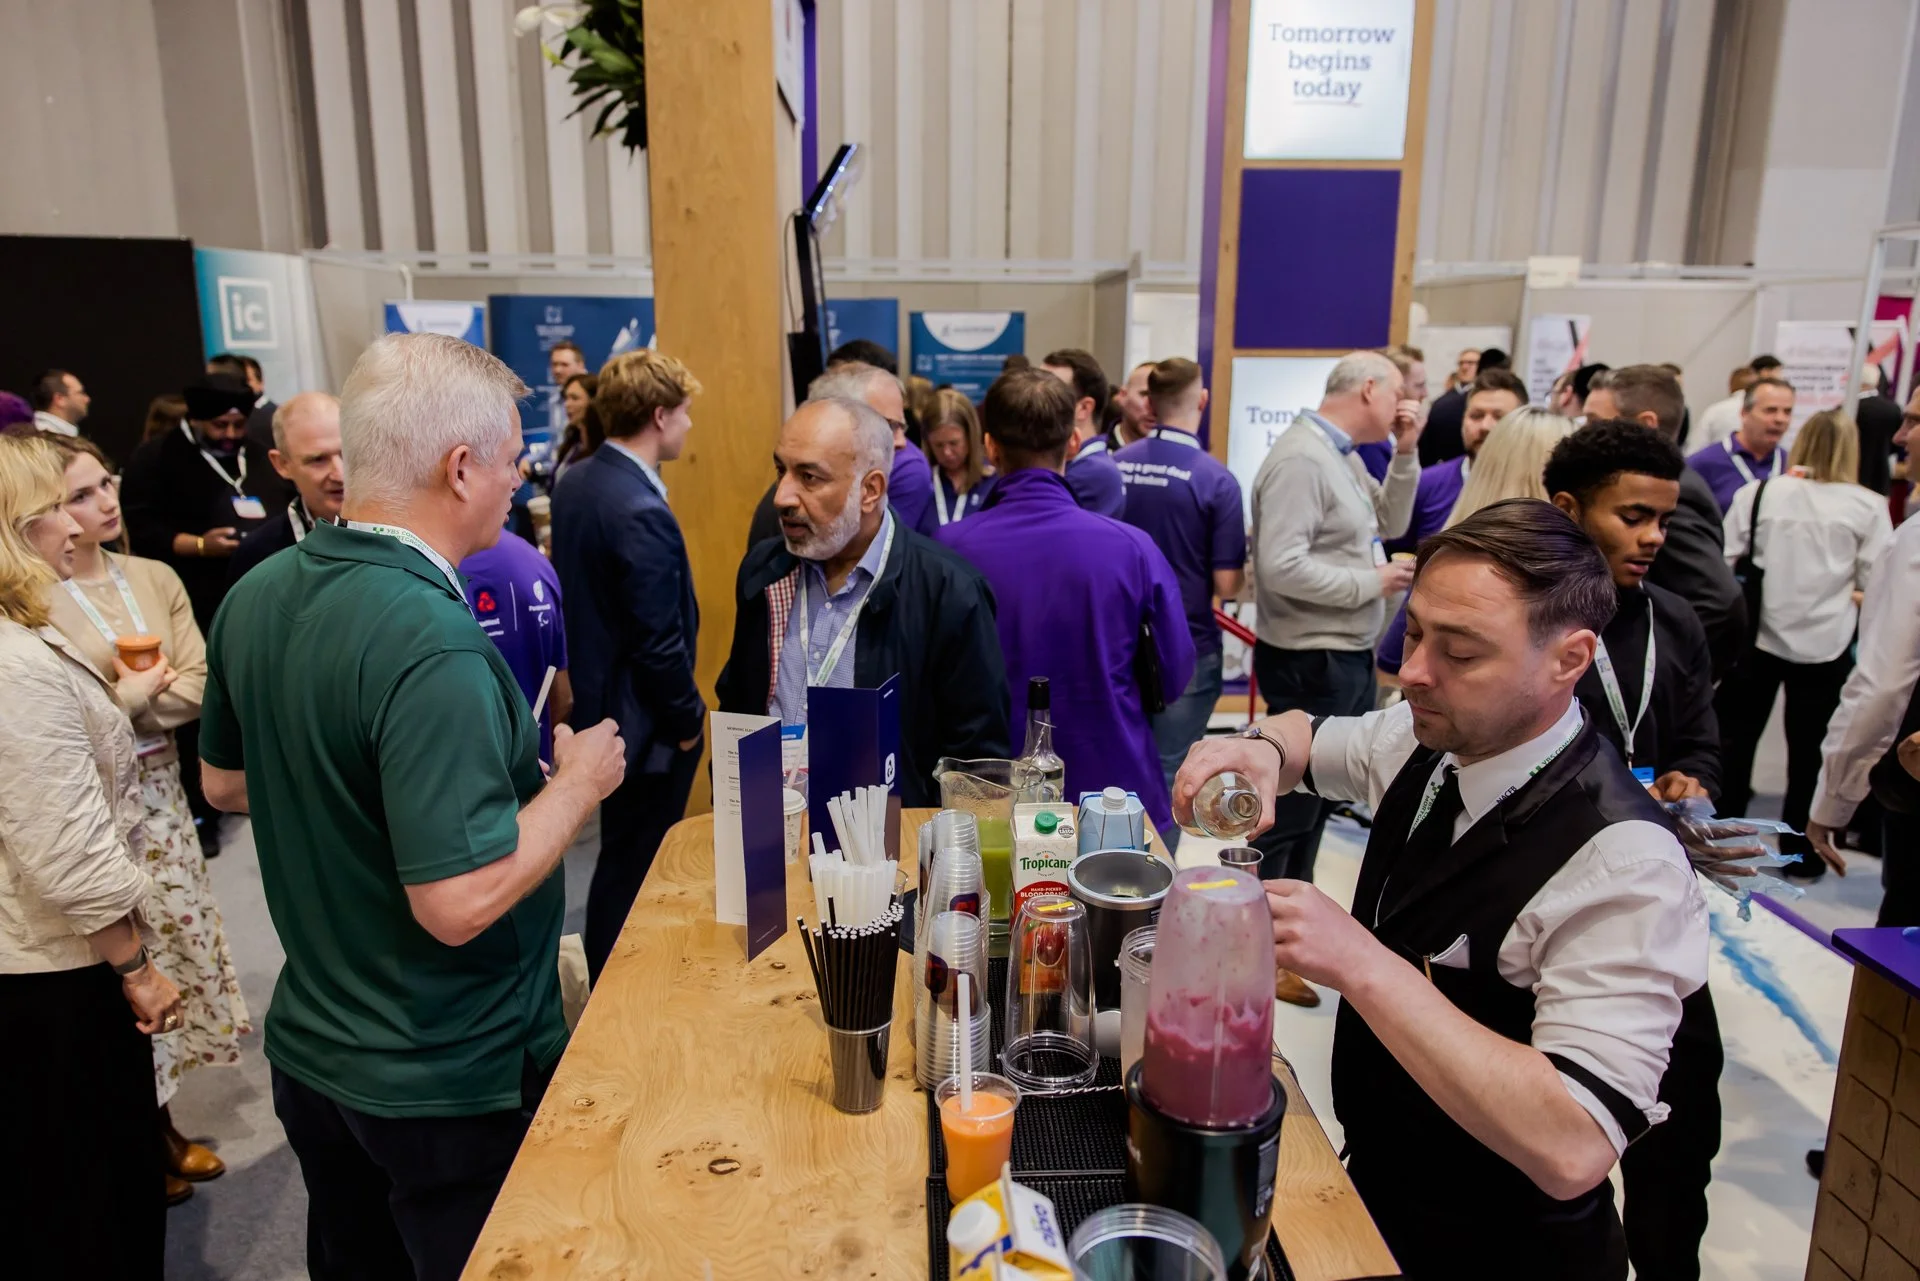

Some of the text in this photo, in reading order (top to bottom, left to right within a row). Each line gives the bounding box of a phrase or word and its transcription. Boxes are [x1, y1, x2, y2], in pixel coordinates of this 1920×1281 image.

[1269, 23, 1396, 43] Tomorrow
[1288, 50, 1373, 75] begins
[1293, 79, 1362, 104] today
[231, 291, 265, 332] ic
